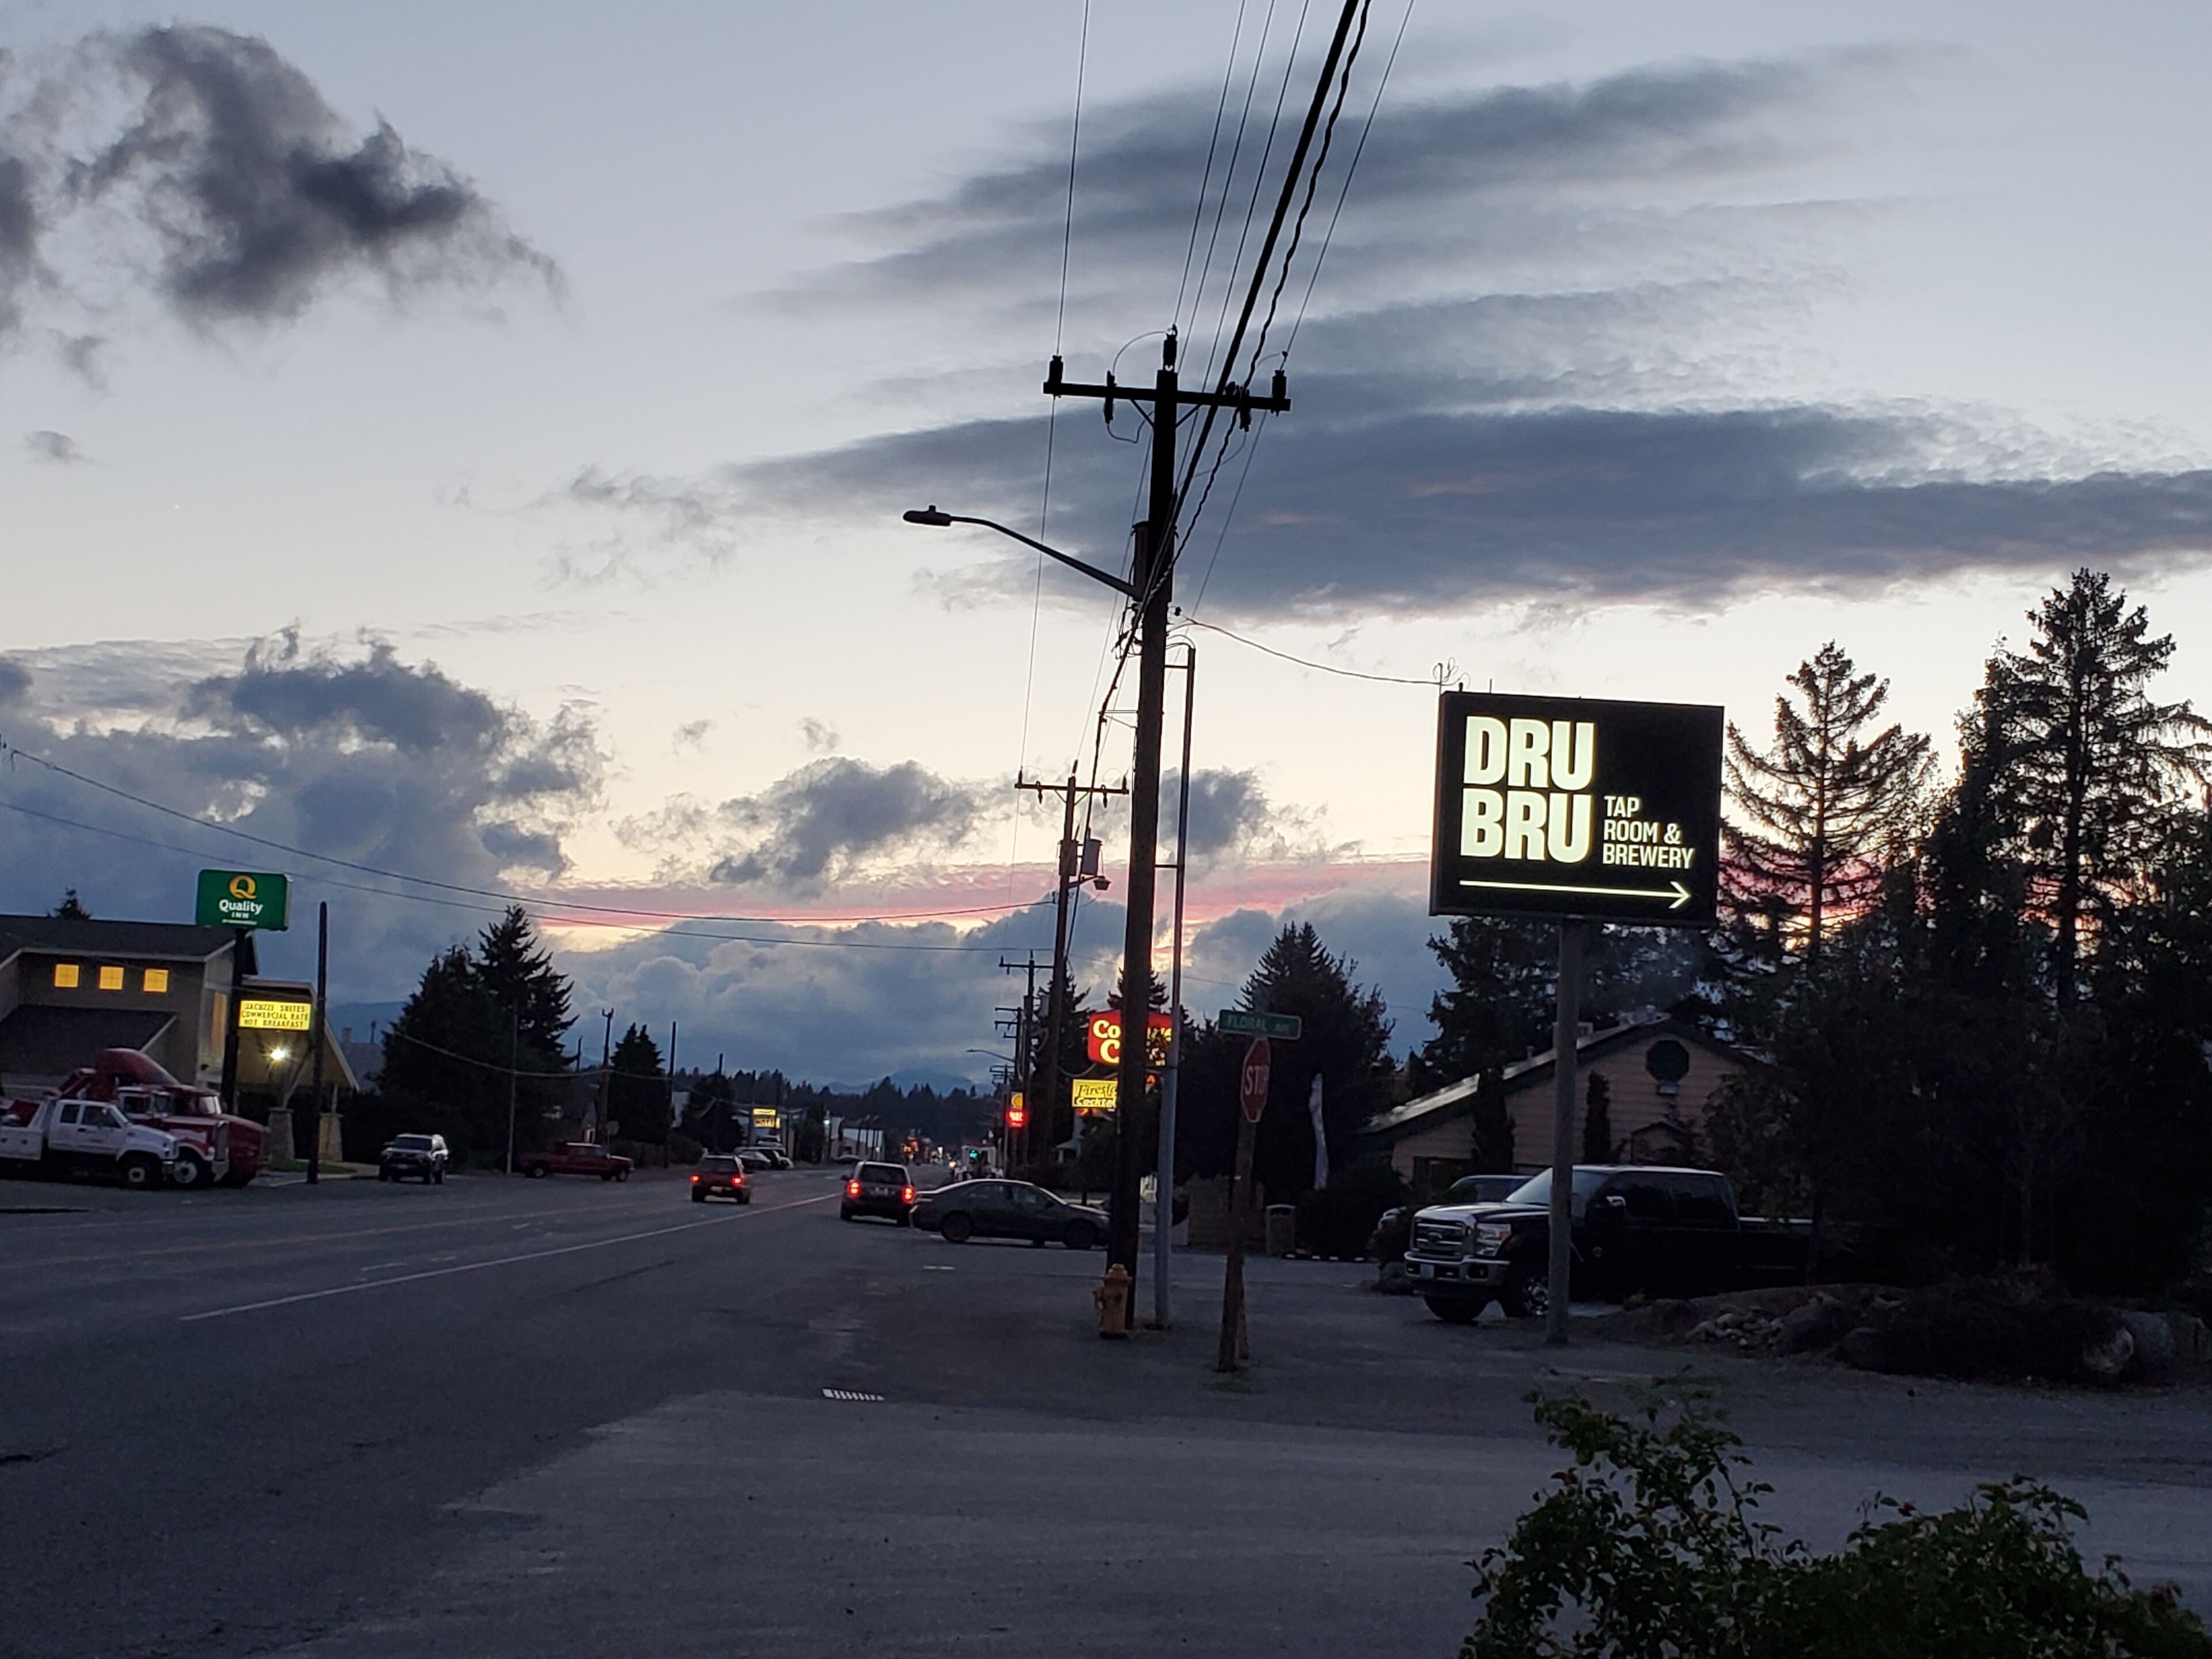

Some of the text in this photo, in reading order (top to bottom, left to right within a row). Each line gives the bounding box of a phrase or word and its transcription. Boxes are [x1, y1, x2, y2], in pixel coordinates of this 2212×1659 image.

[1463, 715, 1594, 791] DRU
[1603, 795, 1641, 818] TAP
[1460, 787, 1592, 863] BRU
[1603, 819, 1681, 845] ROOM &
[1602, 842, 1695, 869] BREWERY
[218, 899, 264, 915] Quality
[241, 1011, 308, 1021] COMMERCIAL RATE
[245, 1003, 305, 1013] JACUZZI SUITES
[263, 1020, 304, 1028] BREAKFAST
[1227, 1014, 1267, 1031] FLORAL
